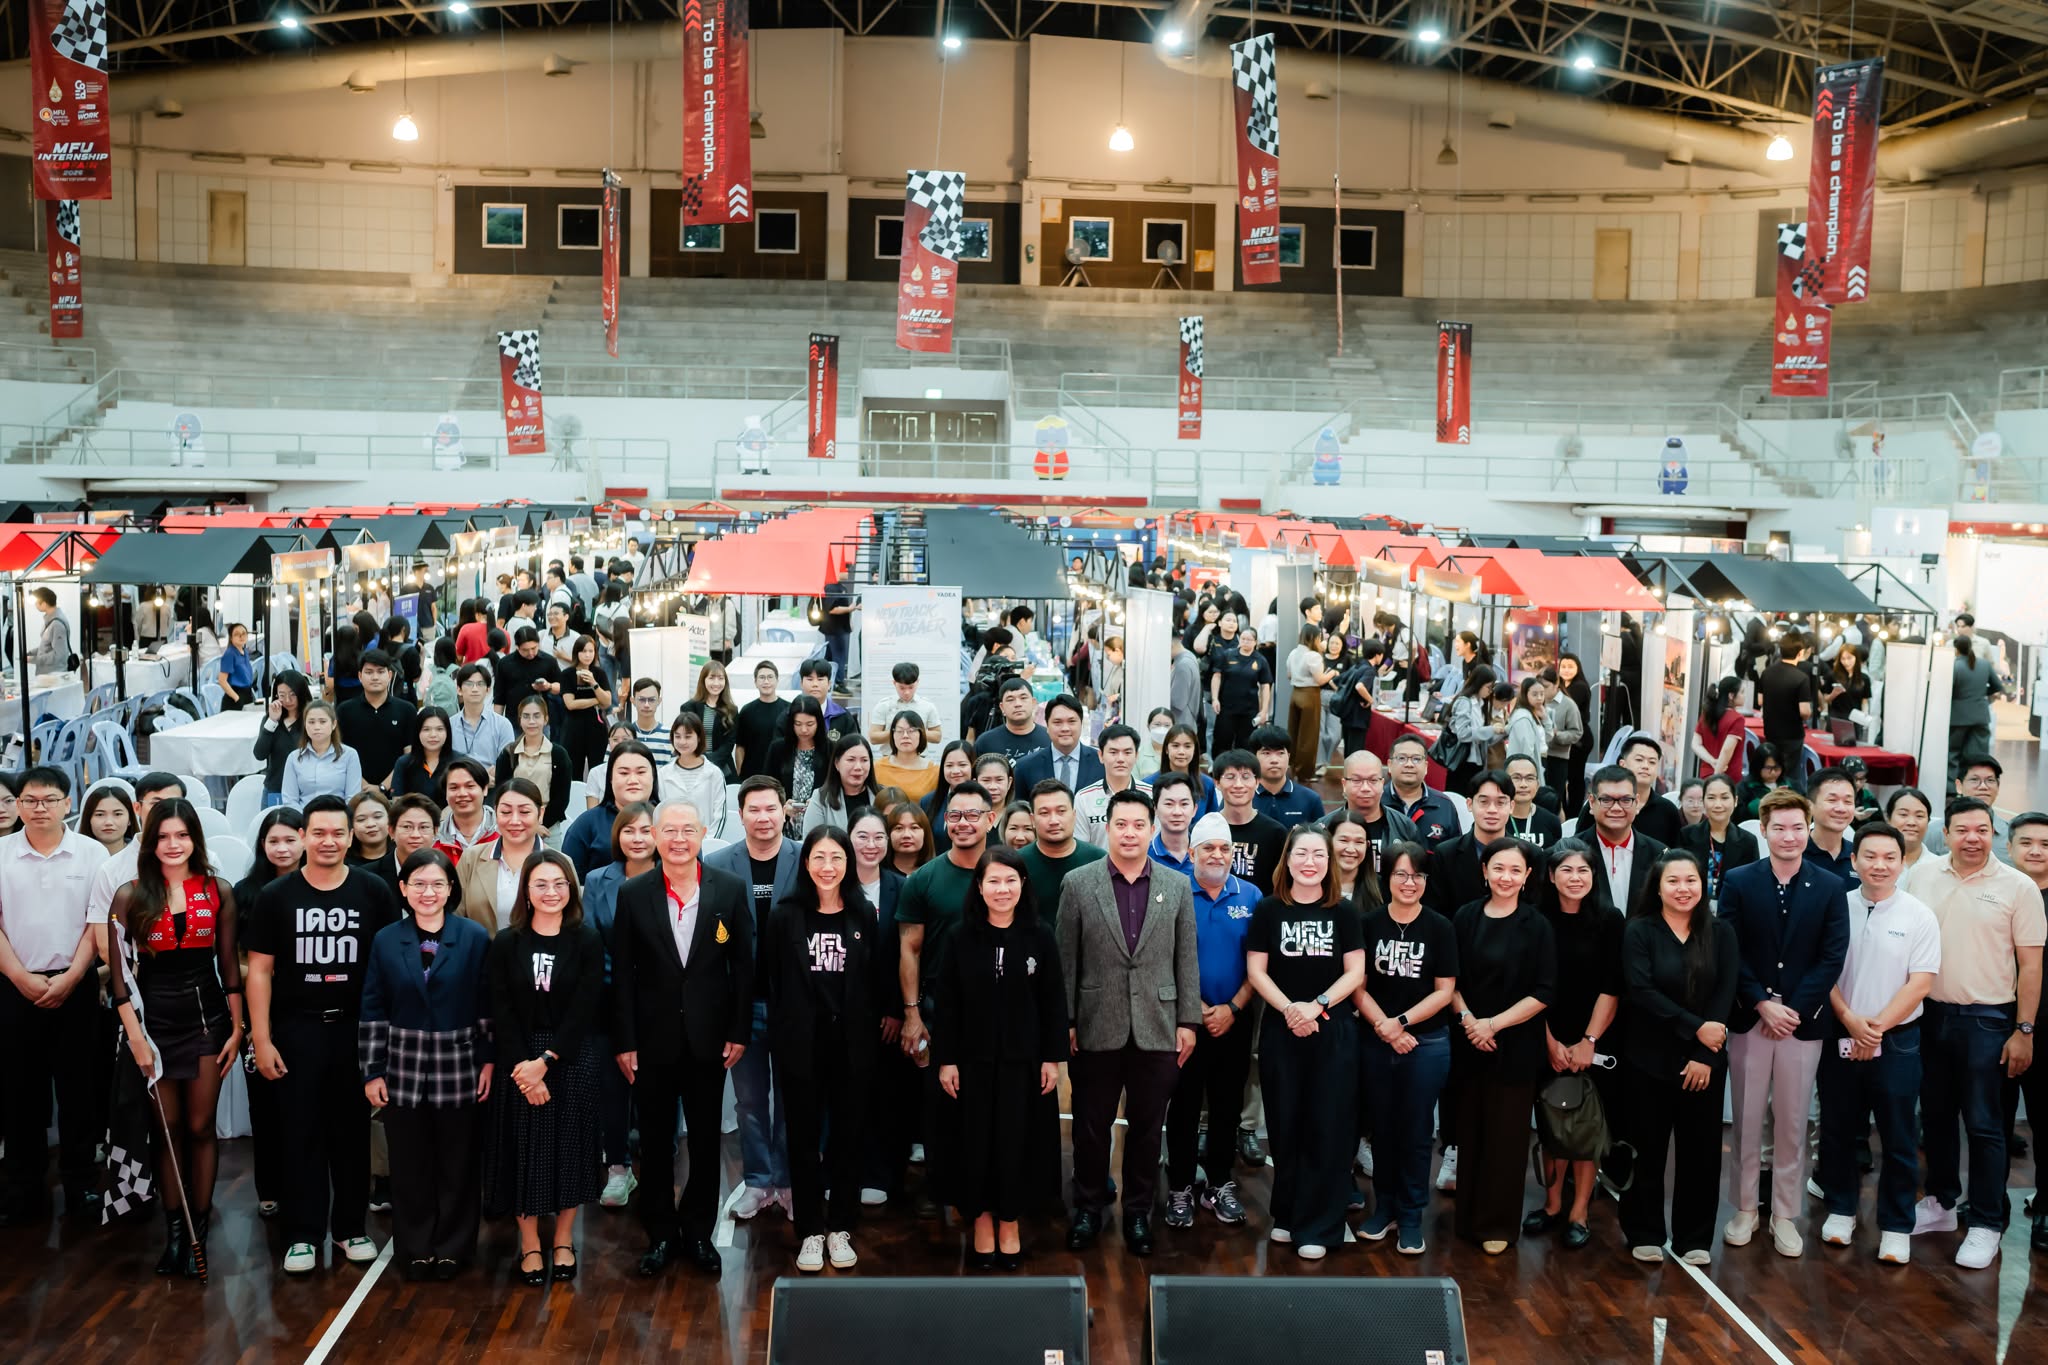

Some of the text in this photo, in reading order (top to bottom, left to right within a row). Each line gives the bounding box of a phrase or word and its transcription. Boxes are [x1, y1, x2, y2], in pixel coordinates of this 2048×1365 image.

[703, 18, 714, 42] To
[703, 47, 718, 69] be
[703, 73, 713, 85] a
[77, 111, 99, 120] WORK
[1832, 106, 1846, 131] To
[52, 142, 94, 154] MFU
[1831, 134, 1845, 156] be
[37, 153, 109, 161] INTERNSHIP
[1830, 160, 1841, 172] a
[1250, 225, 1275, 239] MFU
[58, 295, 77, 304] MFU
[900, 314, 953, 324] INTERNSHIP
[909, 308, 943, 318] MFU
[1784, 356, 1818, 364] MFU
[1232, 842, 1258, 860] FU
[296, 907, 360, 933] เดอะ
[1281, 920, 1333, 940] MFU
[296, 935, 358, 964] แบก
[1375, 939, 1425, 960] MFU
